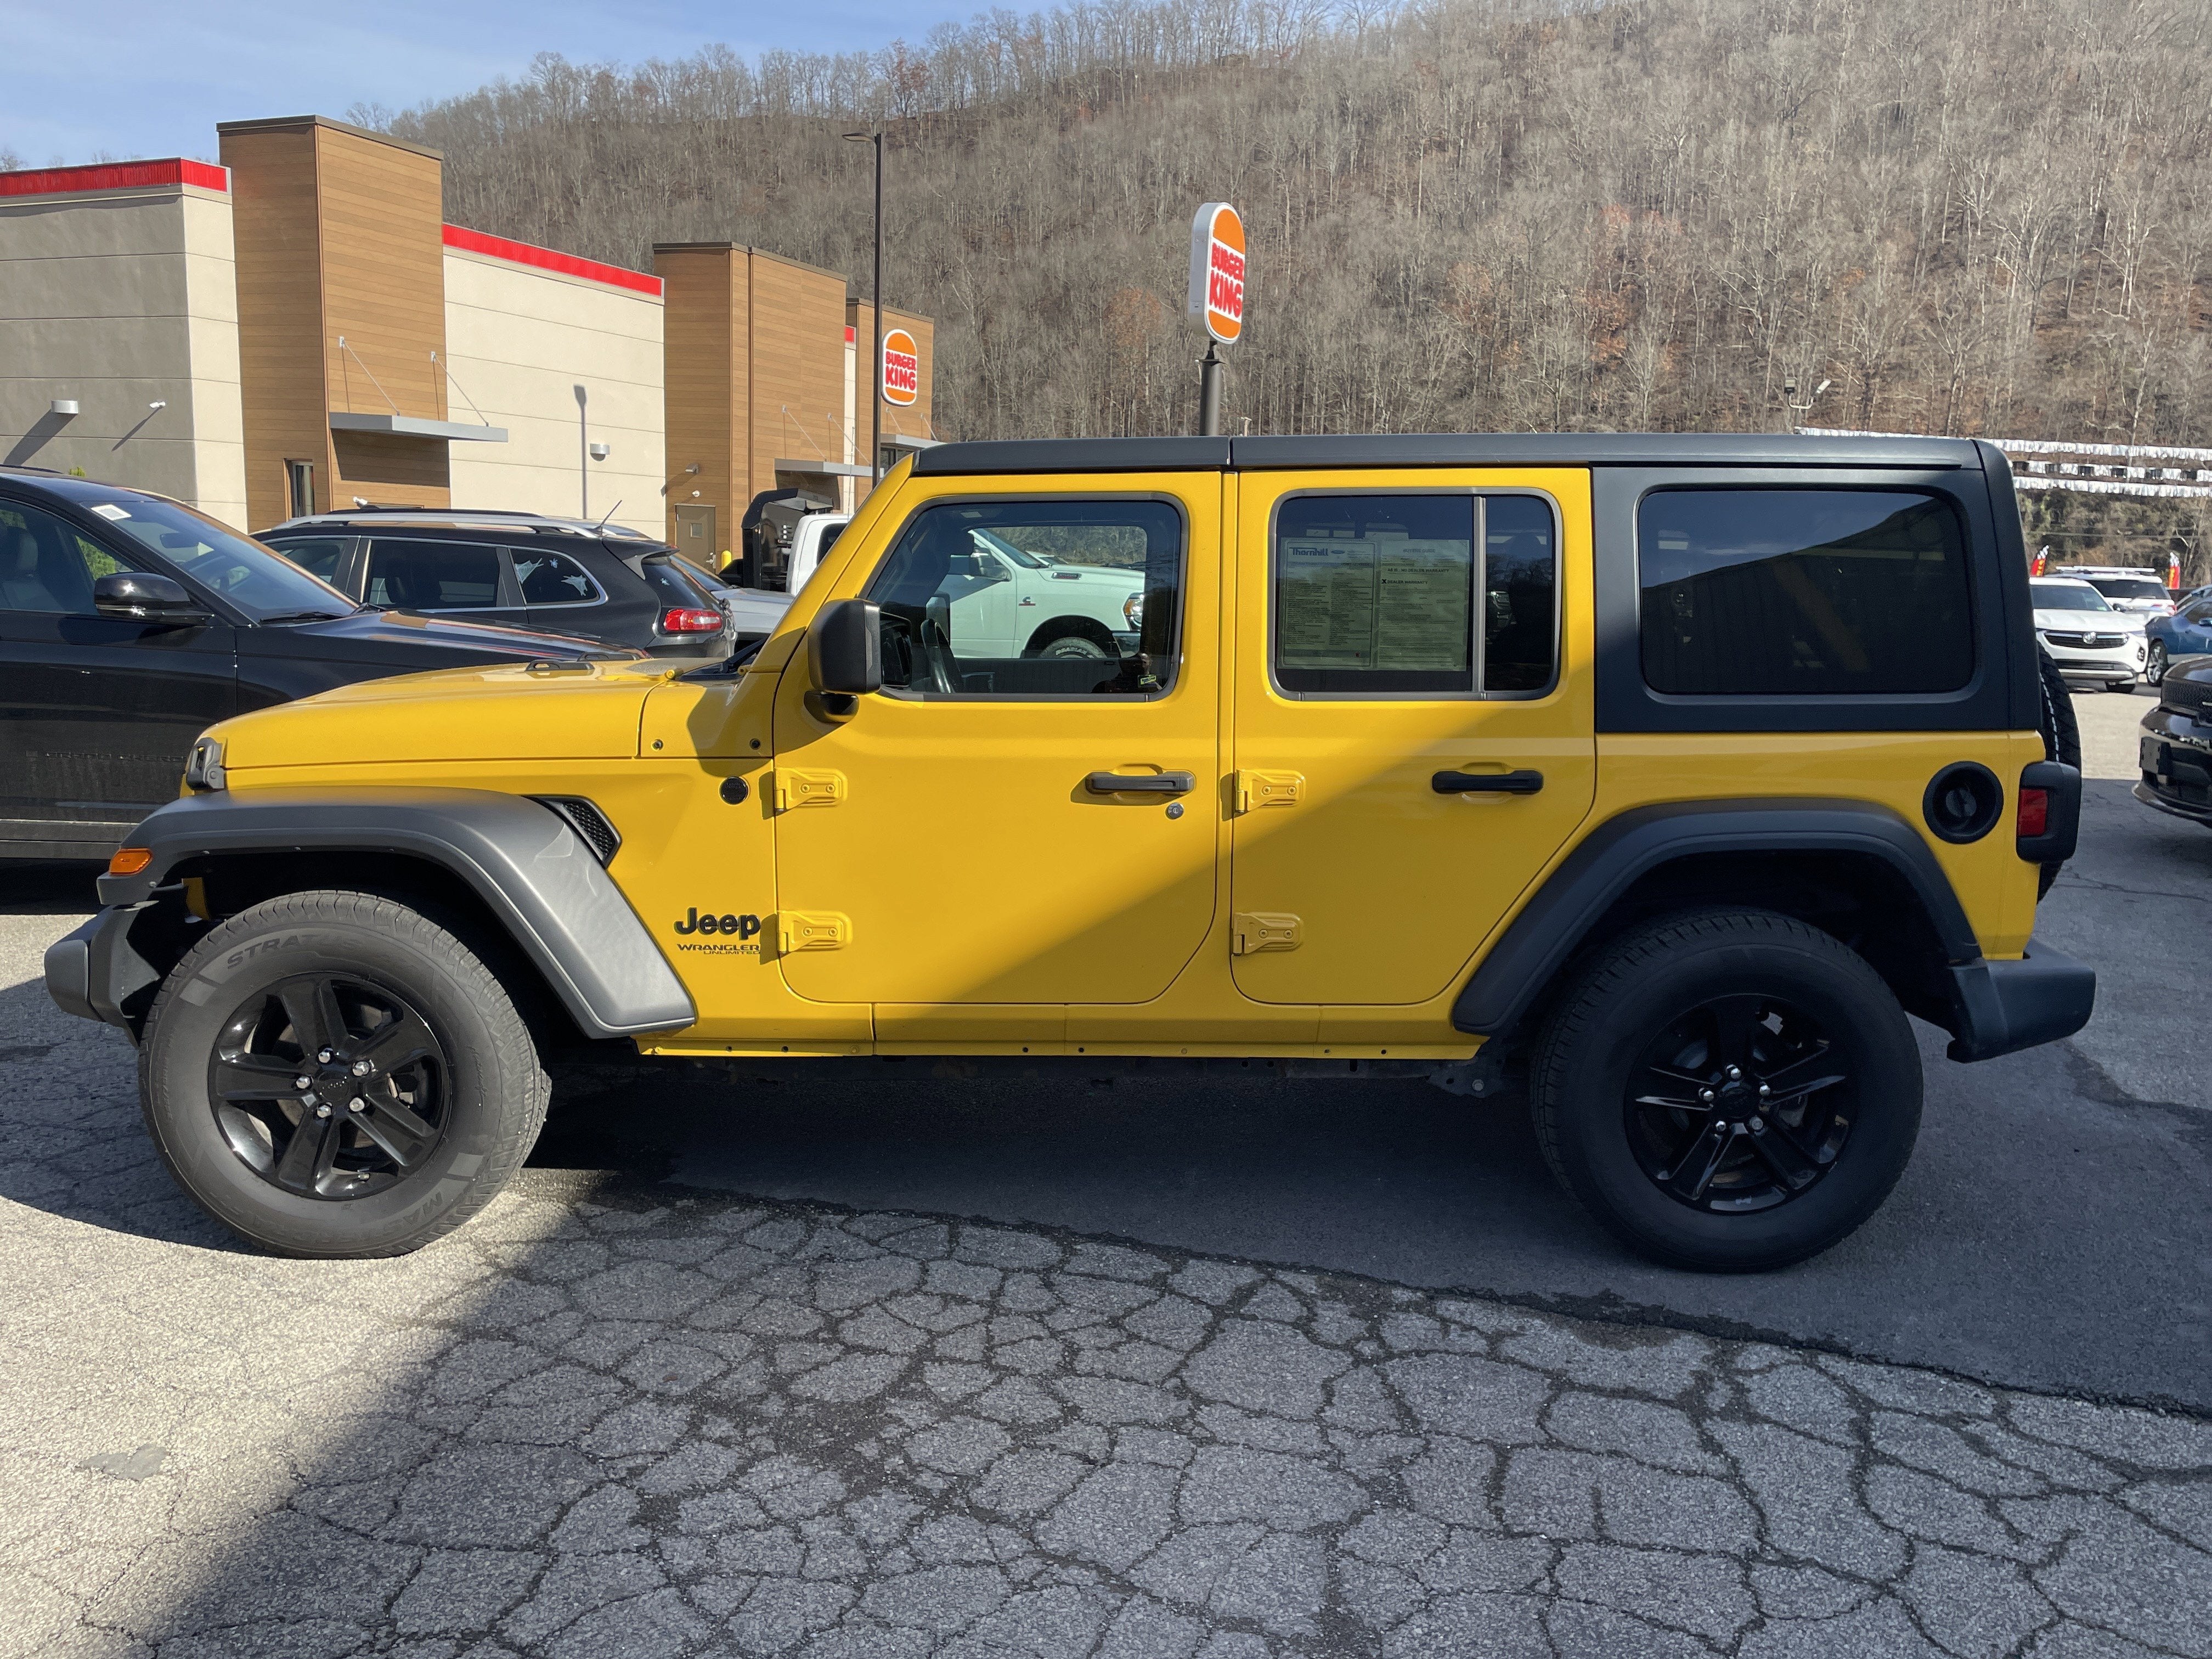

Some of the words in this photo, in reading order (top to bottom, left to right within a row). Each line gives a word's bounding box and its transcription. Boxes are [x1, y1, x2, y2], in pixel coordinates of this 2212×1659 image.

[1211, 242, 1245, 283] BURGER
[1209, 269, 1243, 318] KING
[885, 351, 916, 371] BURGER
[885, 365, 916, 391] KING
[1289, 547, 1329, 556] Thornhill
[117, 754, 188, 763] CHERO
[674, 907, 761, 941] Jeep
